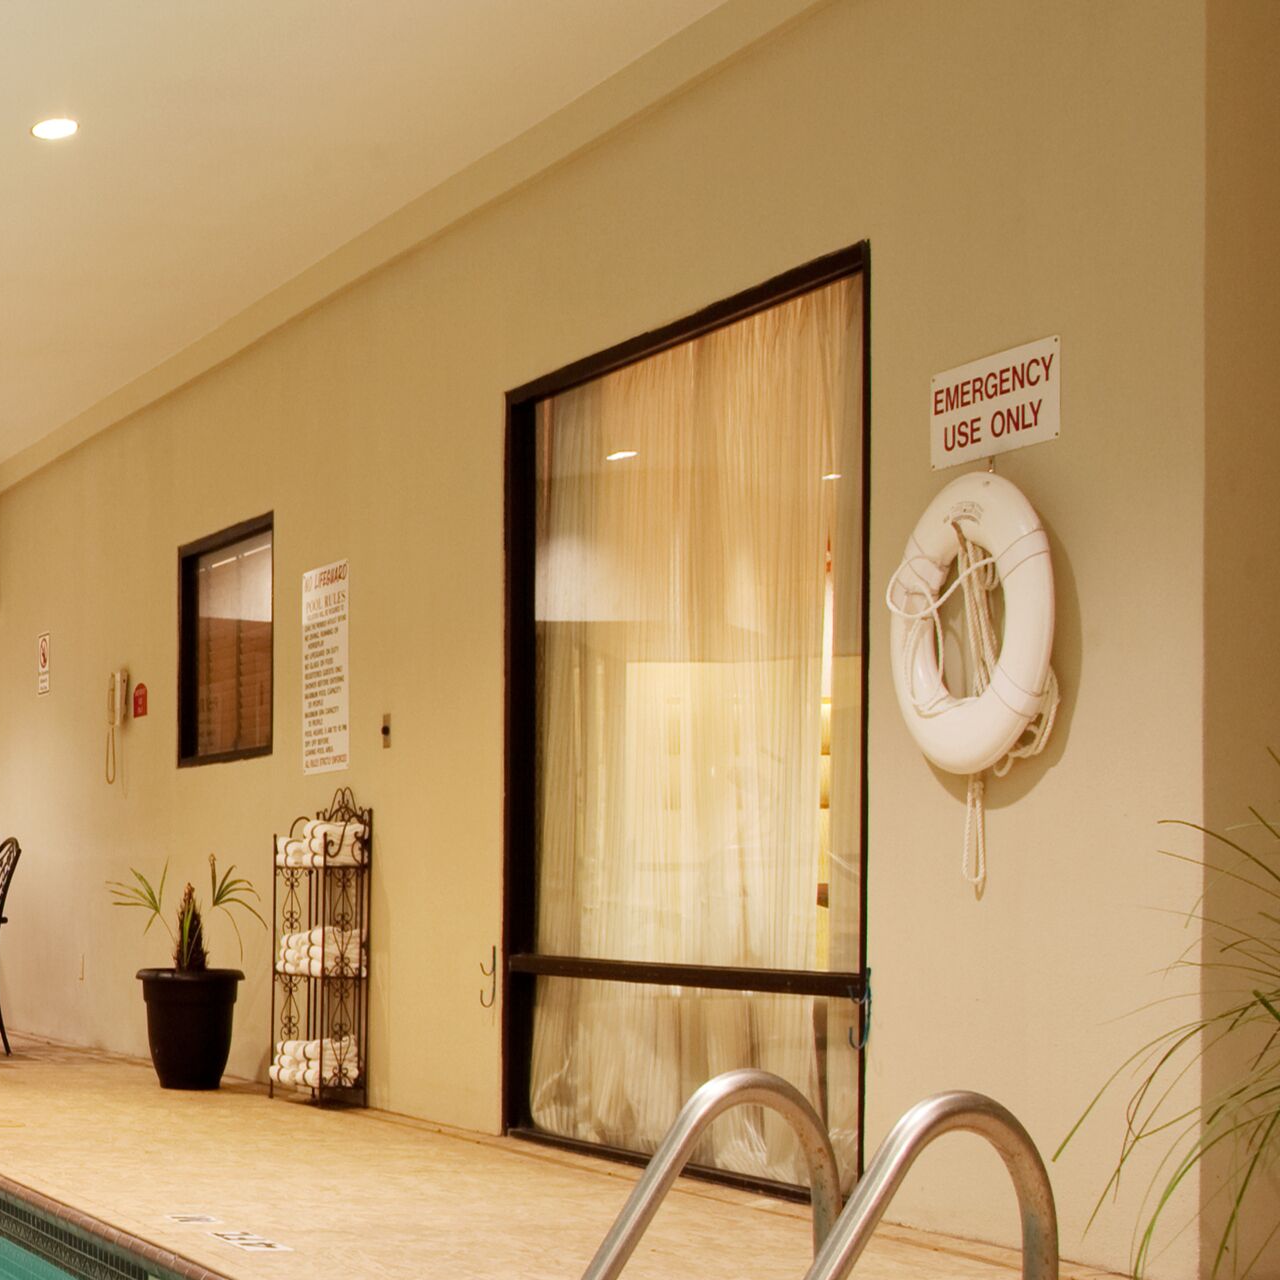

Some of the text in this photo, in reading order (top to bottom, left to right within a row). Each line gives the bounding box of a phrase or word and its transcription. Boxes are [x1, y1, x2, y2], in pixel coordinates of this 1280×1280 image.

[934, 353, 1054, 416] EMERGENCY
[944, 398, 1042, 451] USE ONLY
[314, 565, 347, 590] LIFEGUARD
[306, 597, 322, 613] POOL
[325, 590, 346, 608] RULES
